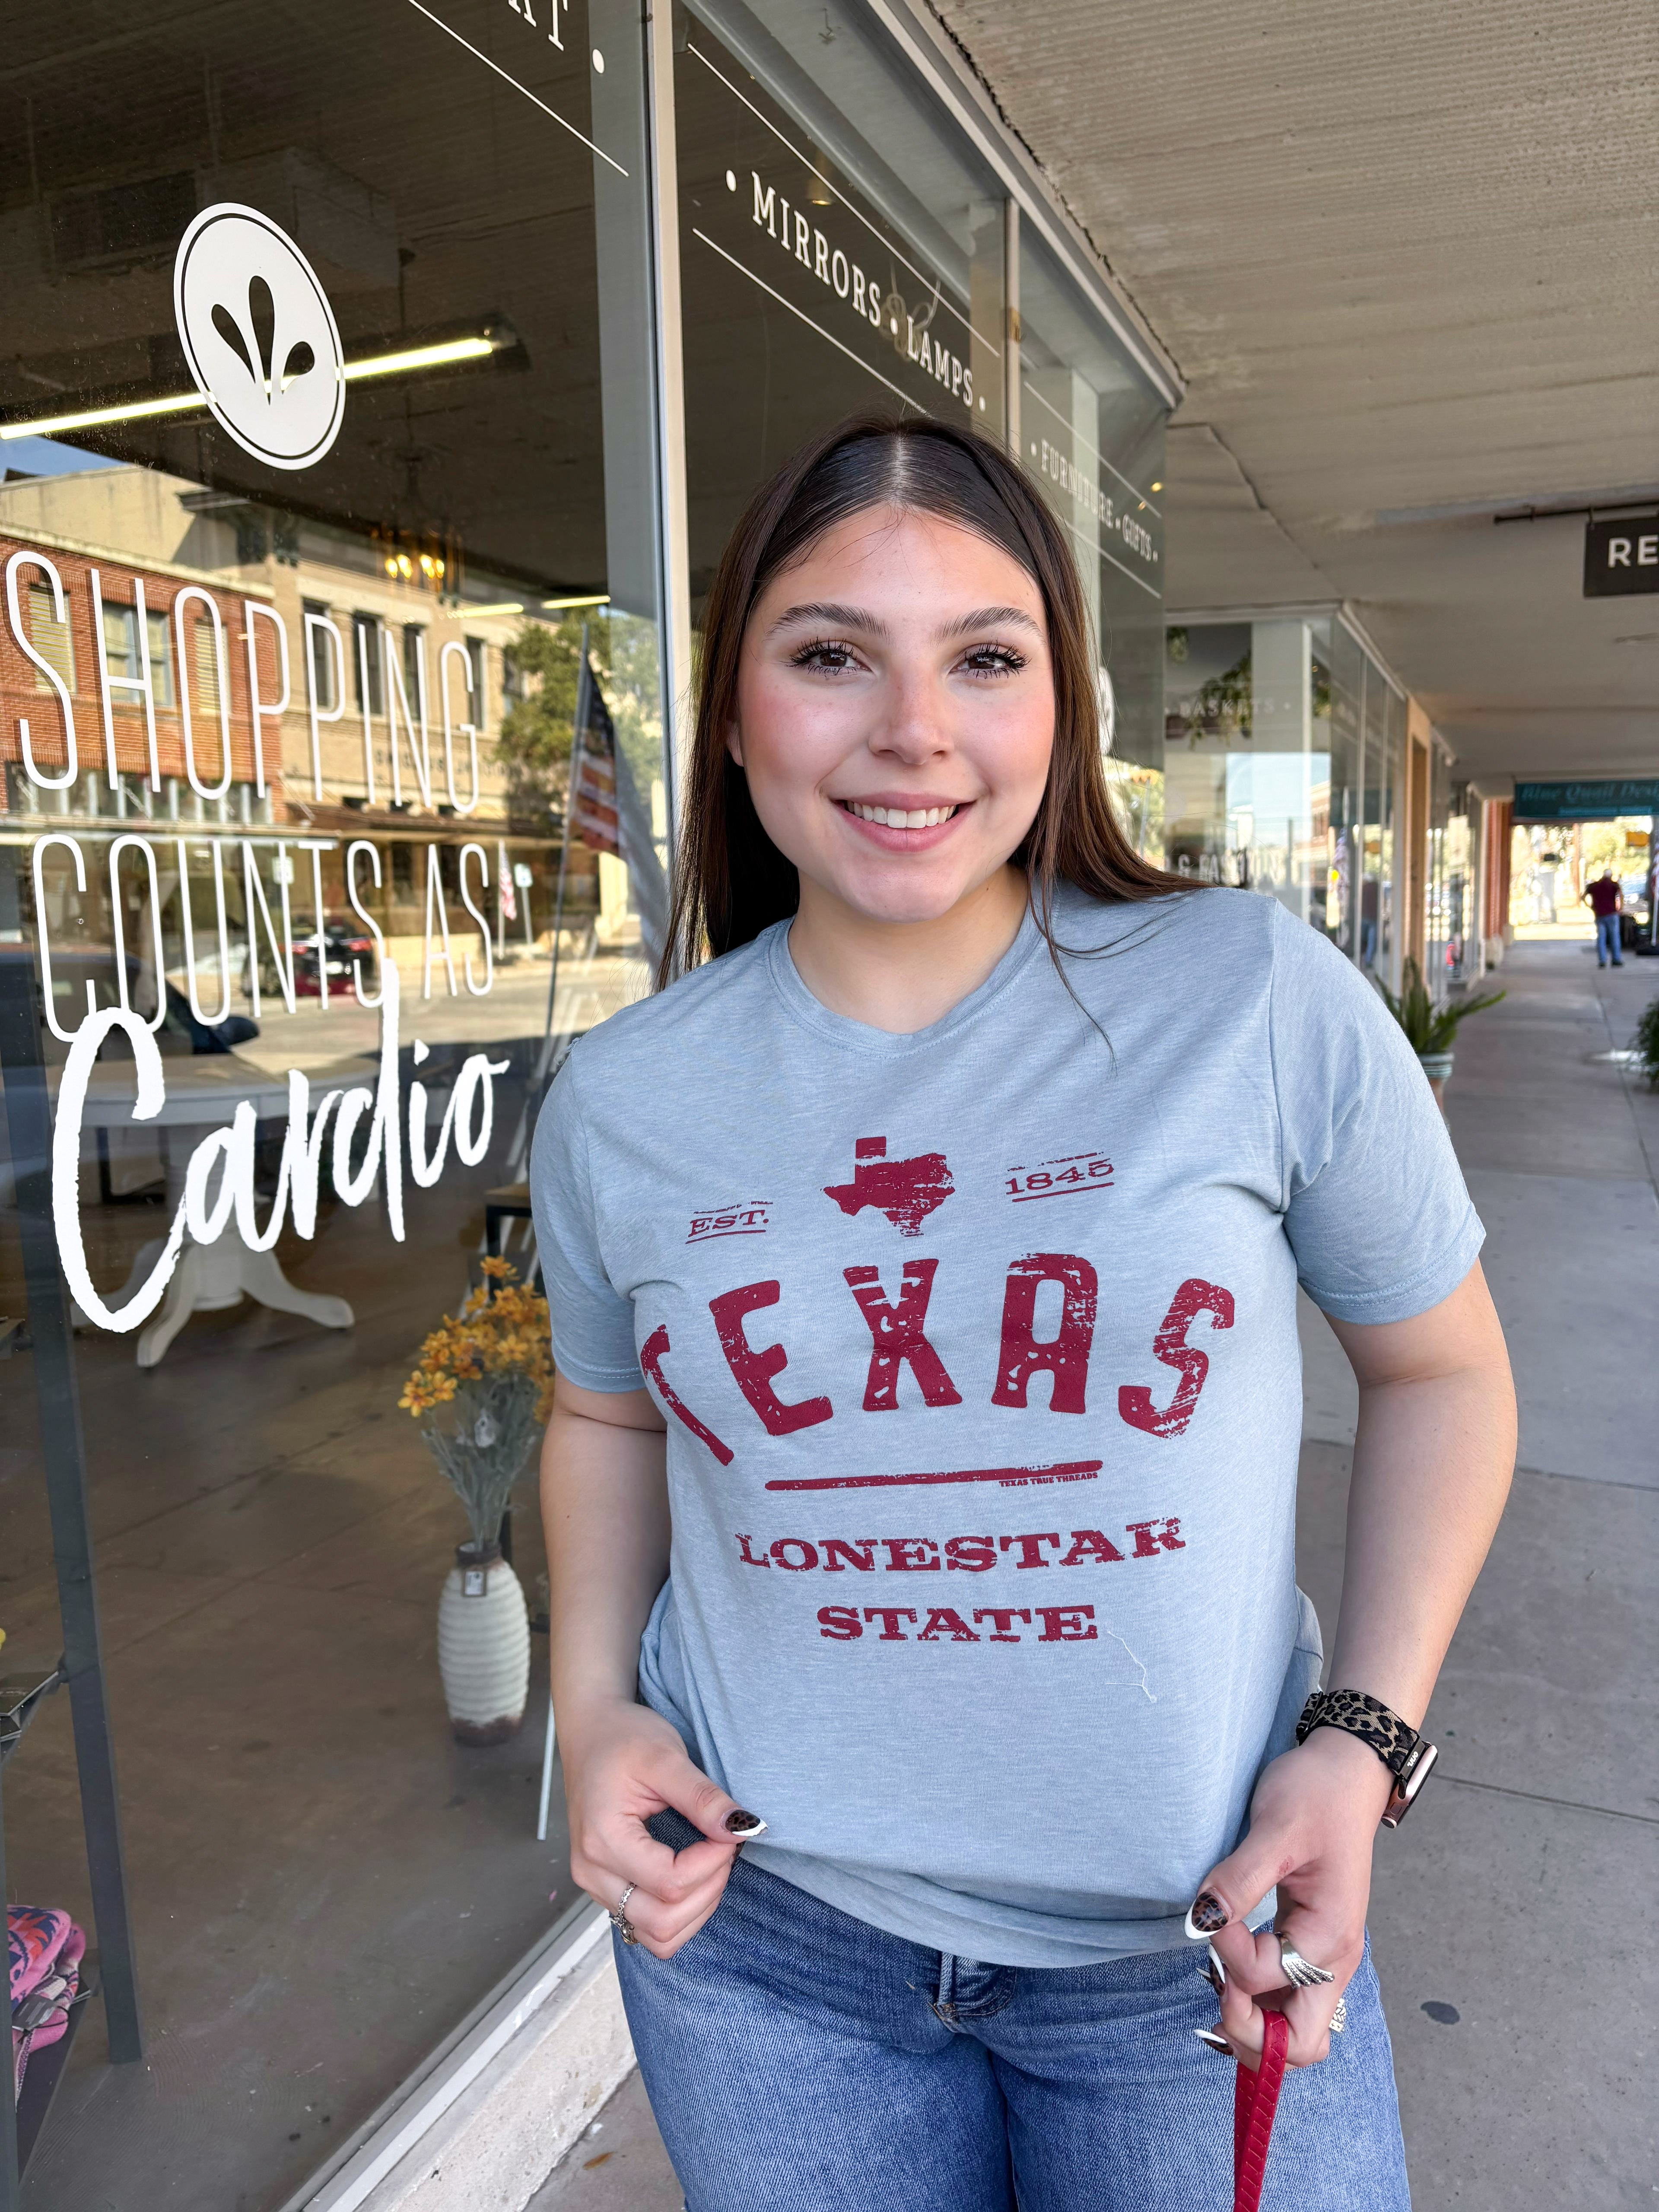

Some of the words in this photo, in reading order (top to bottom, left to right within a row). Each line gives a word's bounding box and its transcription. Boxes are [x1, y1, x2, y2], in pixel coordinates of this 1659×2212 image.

[752, 171, 881, 327] MIRRORS
[907, 315, 973, 407] LAMPS
[1041, 438, 1114, 529] FURNITURE
[6, 550, 479, 814] SHOPPING
[32, 834, 386, 1042] COUNTS
[424, 843, 493, 999] AS
[52, 957, 510, 1333] Cardio
[1006, 1159, 1115, 1195] 1845
[688, 1210, 769, 1238] EST.
[640, 1253, 1235, 1466] TEXAS
[1030, 1476, 1054, 1485] TRUE
[1055, 1472, 1098, 1483] THREADS
[734, 1517, 1187, 1573] LONESTAR
[817, 1605, 1098, 1643] STATE
